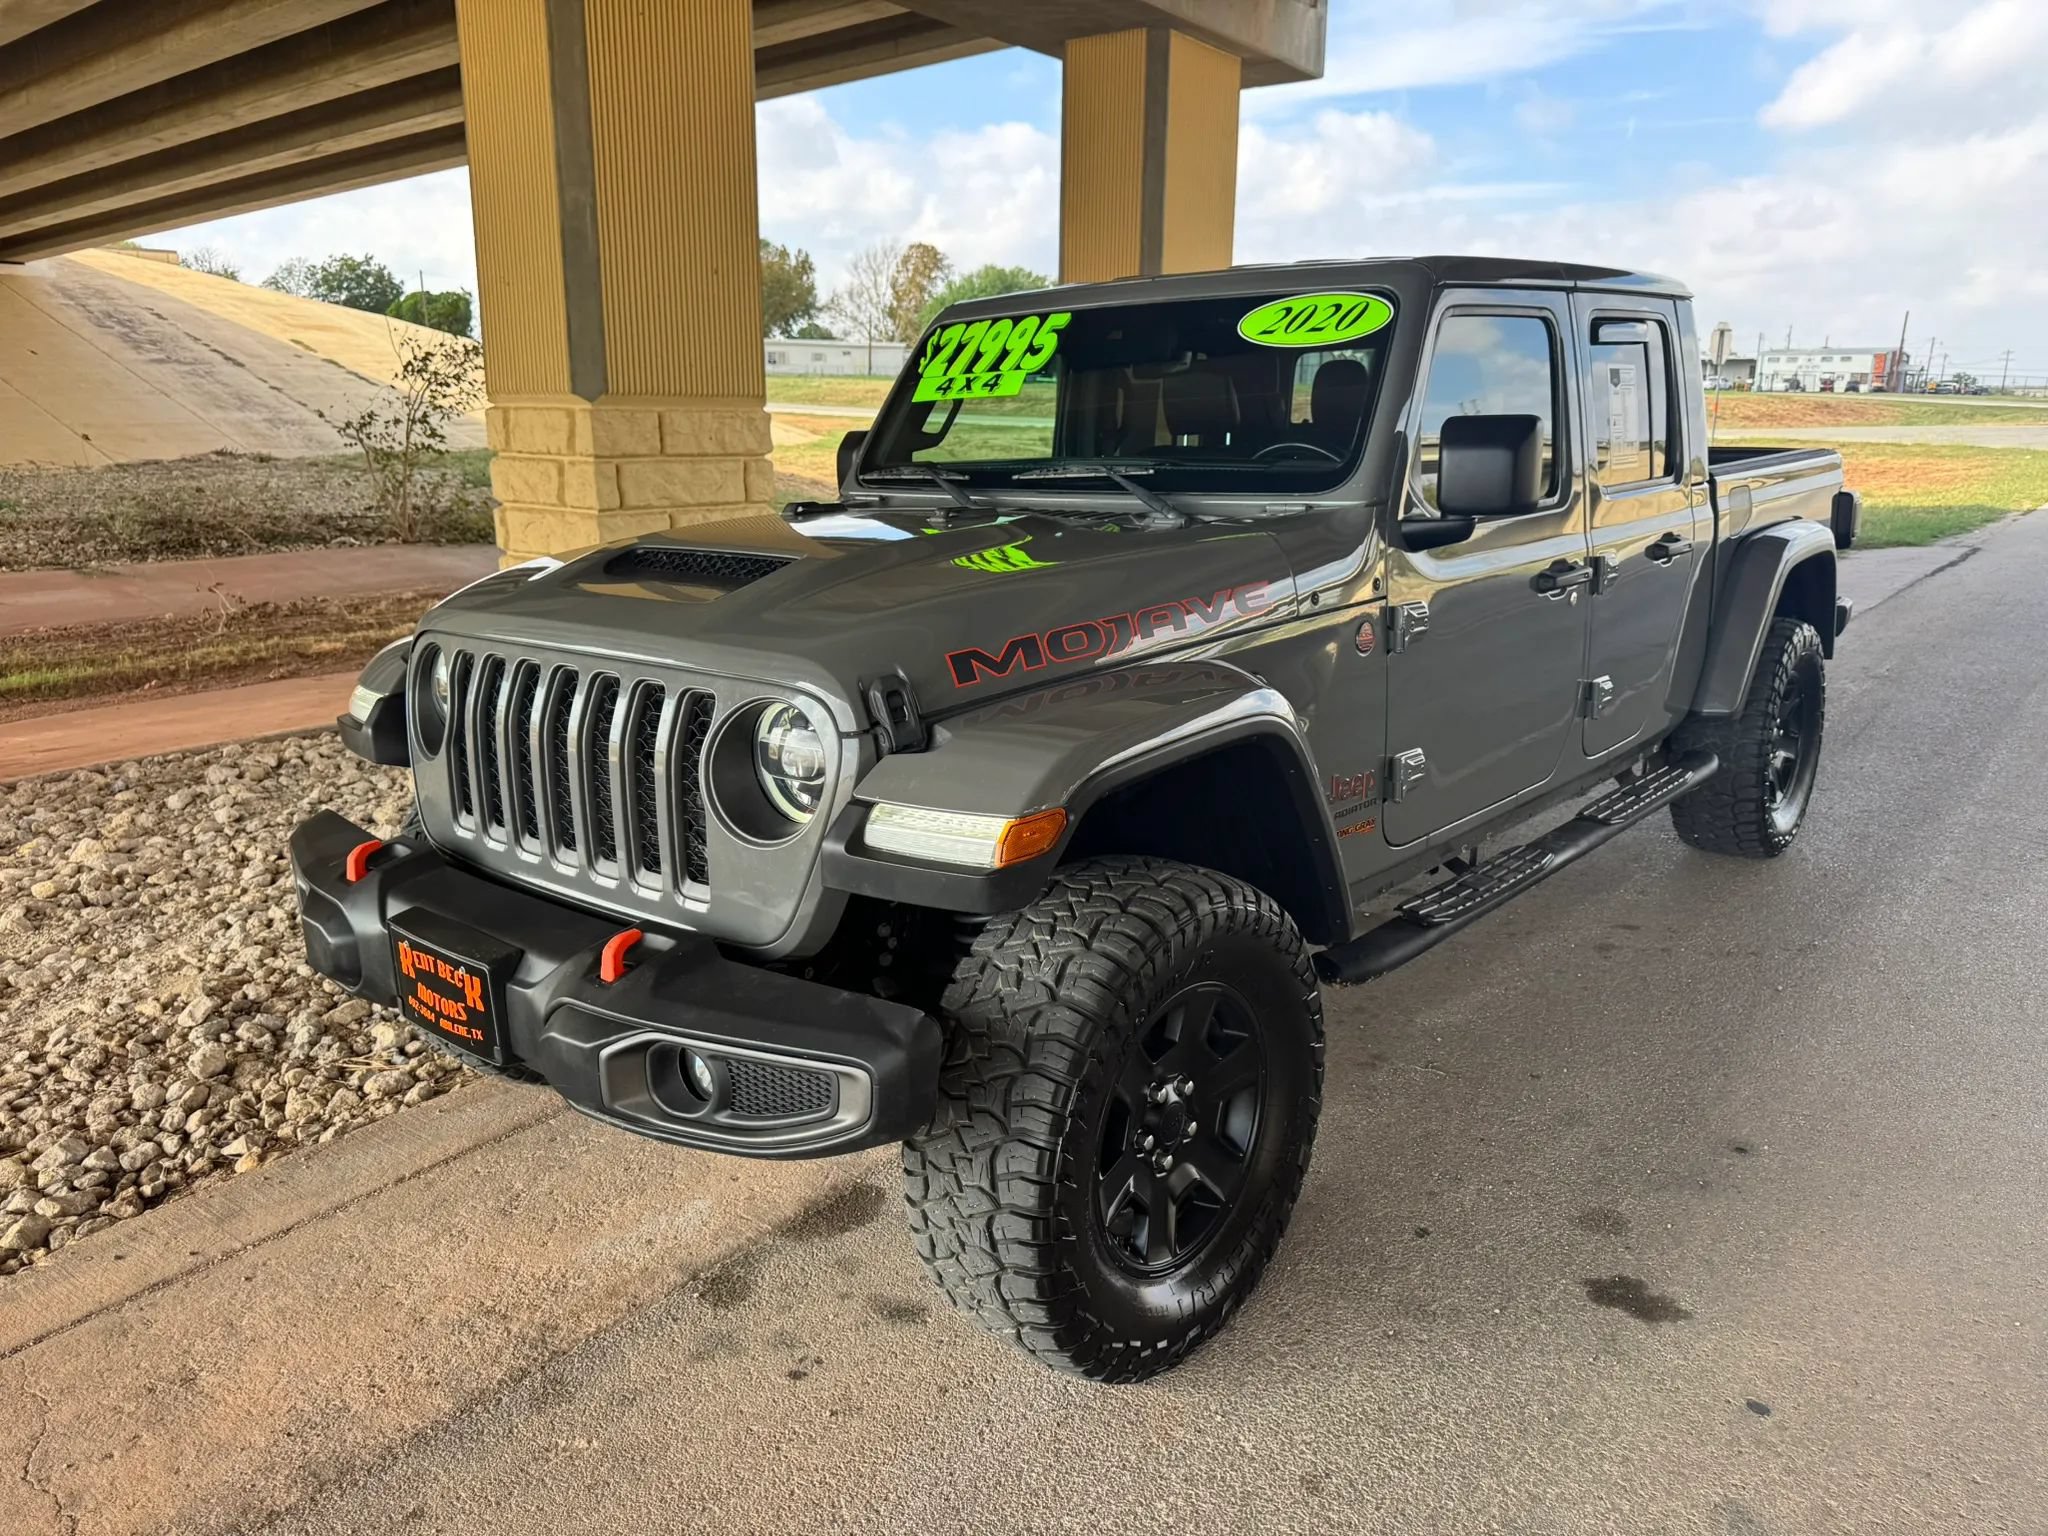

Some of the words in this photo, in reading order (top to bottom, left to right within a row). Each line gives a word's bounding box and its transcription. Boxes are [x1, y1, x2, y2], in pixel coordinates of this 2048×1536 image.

[1256, 301, 1370, 336] 2020
[918, 312, 1072, 378] $27995
[944, 580, 1269, 688] MOJAVE
[1326, 769, 1376, 804] Jeep
[417, 982, 467, 1021] MOTORS
[437, 959, 484, 1012] BECK
[470, 1028, 484, 1041] TX
